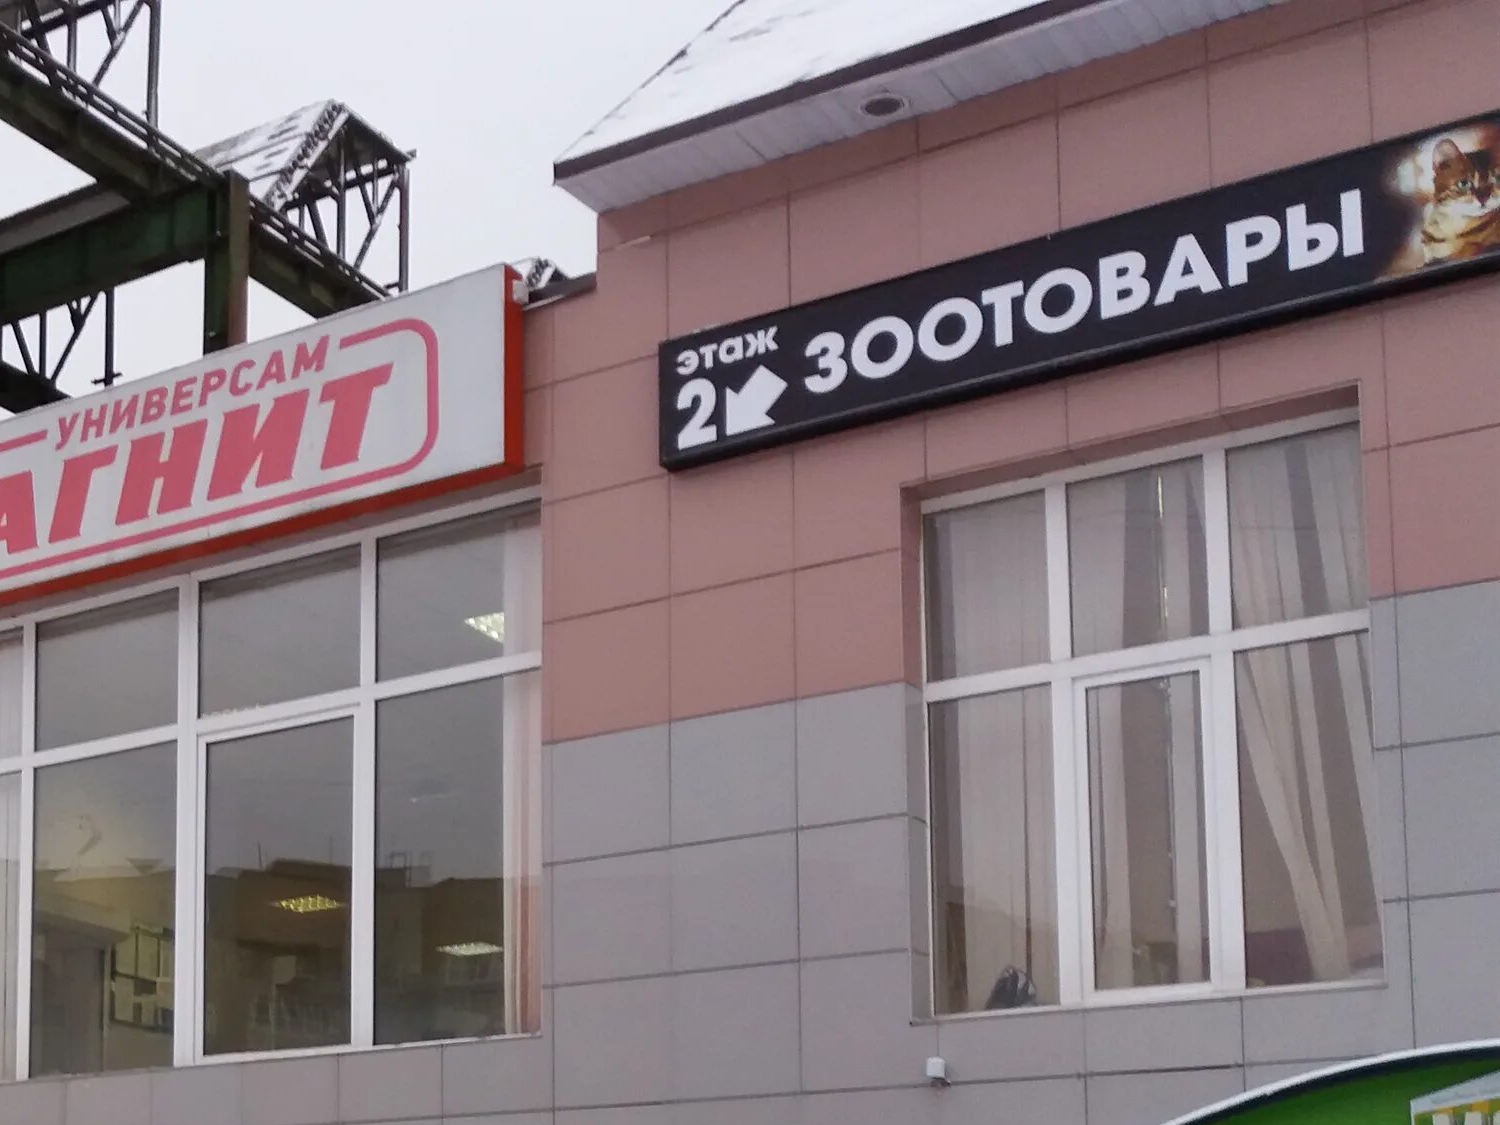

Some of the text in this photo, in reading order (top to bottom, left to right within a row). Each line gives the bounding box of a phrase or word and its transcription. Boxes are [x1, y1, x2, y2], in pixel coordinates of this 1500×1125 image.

[804, 188, 1365, 395] ЗООТОВАРЫ
[53, 335, 332, 451] УНИВЕРСАМ
[675, 325, 779, 377] этаж
[675, 378, 718, 451] 2
